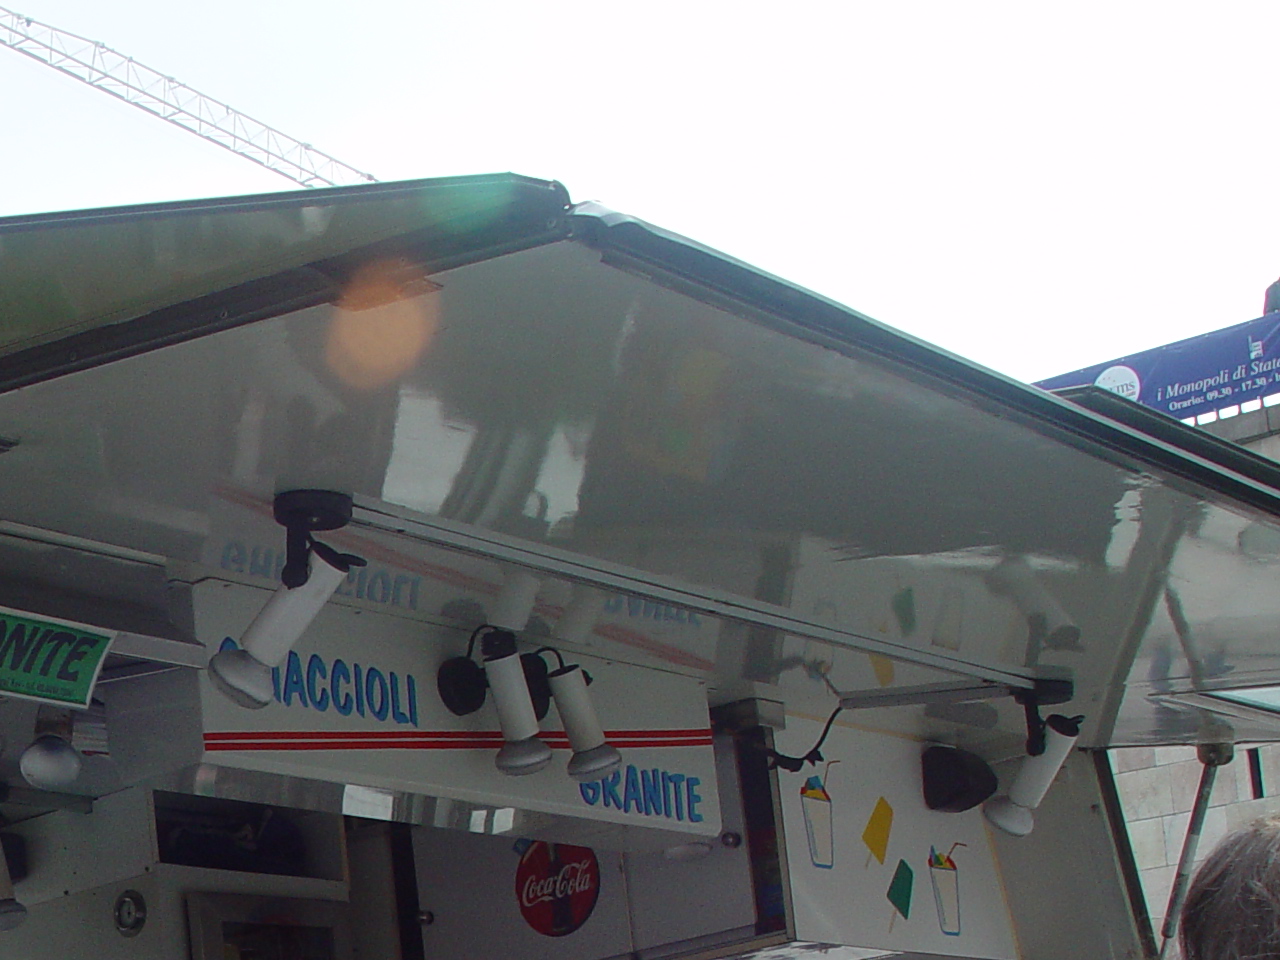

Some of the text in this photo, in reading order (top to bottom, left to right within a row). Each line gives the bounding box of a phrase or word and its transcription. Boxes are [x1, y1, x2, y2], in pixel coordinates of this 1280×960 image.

[1165, 368, 1229, 400] Monopoli
[1232, 364, 1247, 381] di
[522, 859, 591, 907] Coca-Cola
